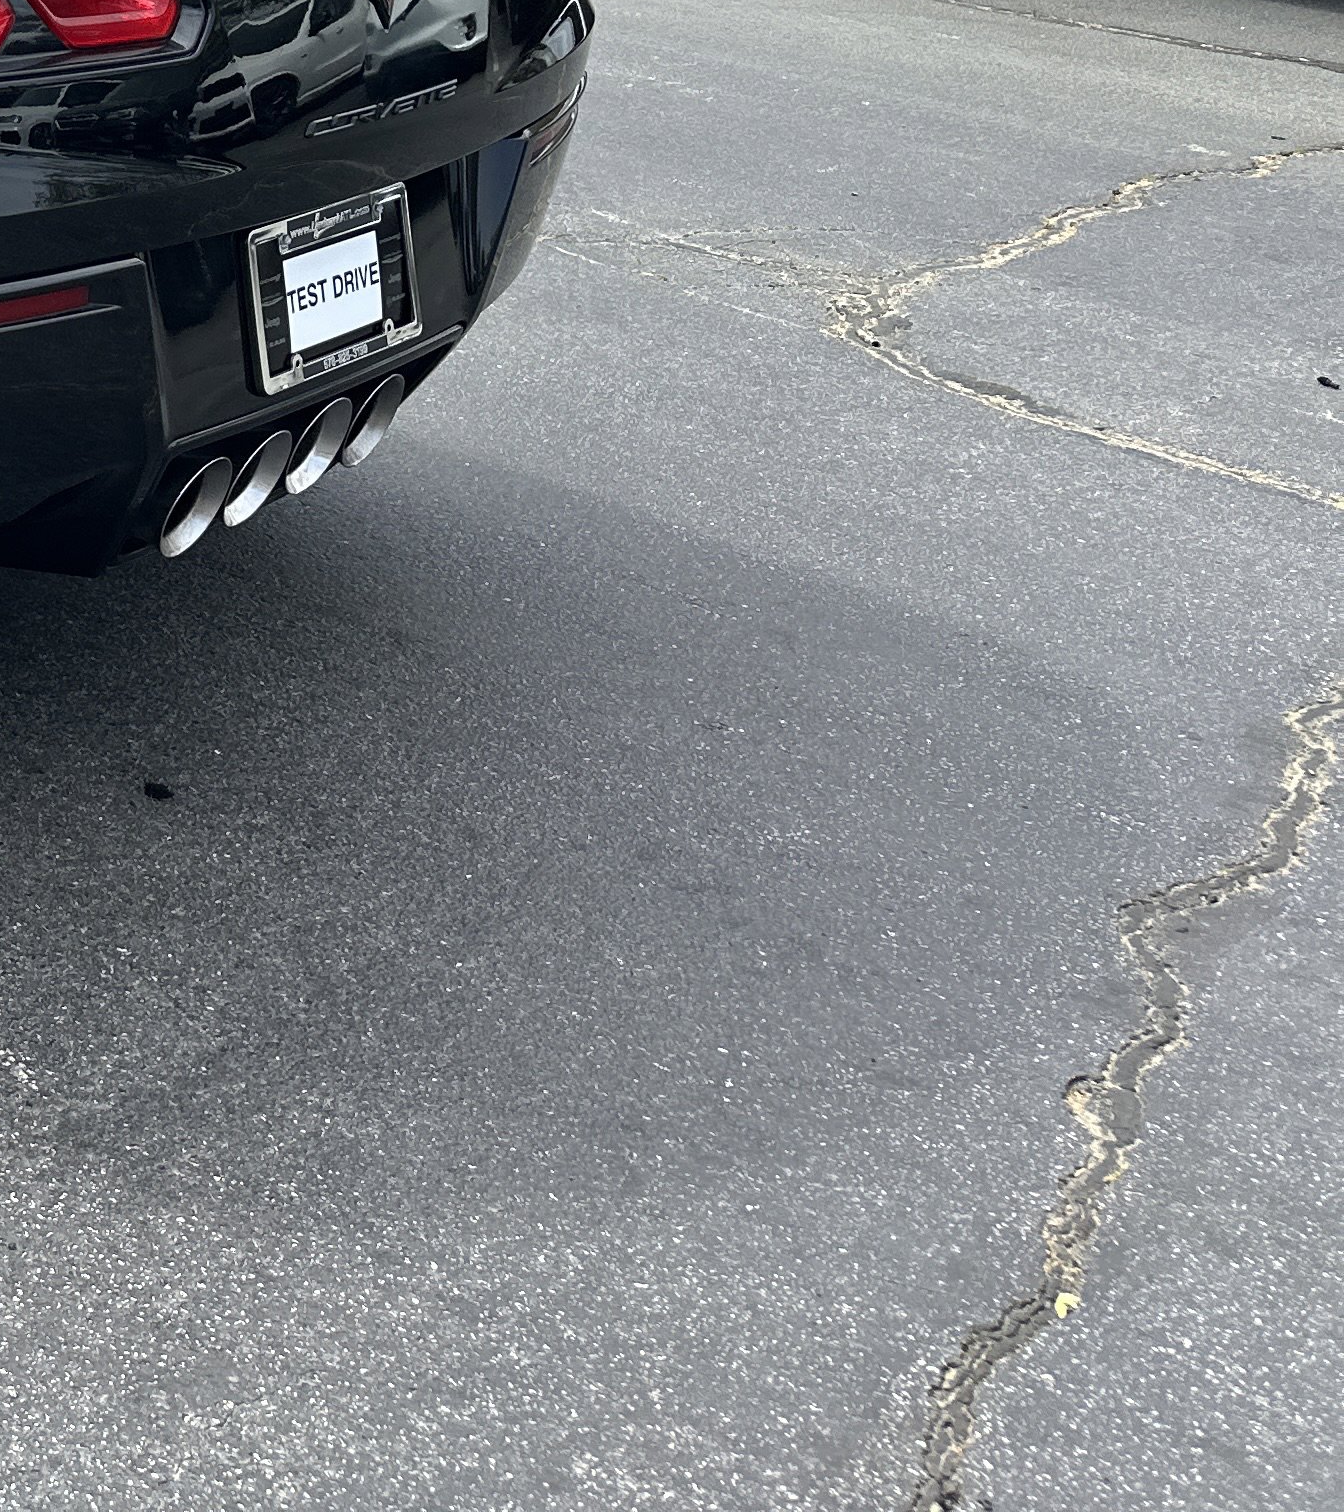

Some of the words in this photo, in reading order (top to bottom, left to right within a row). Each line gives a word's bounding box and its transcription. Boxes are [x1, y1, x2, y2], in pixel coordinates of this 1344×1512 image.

[303, 78, 458, 138] CORVETTE
[286, 278, 327, 314] TEST
[332, 260, 380, 299] DRIVE
